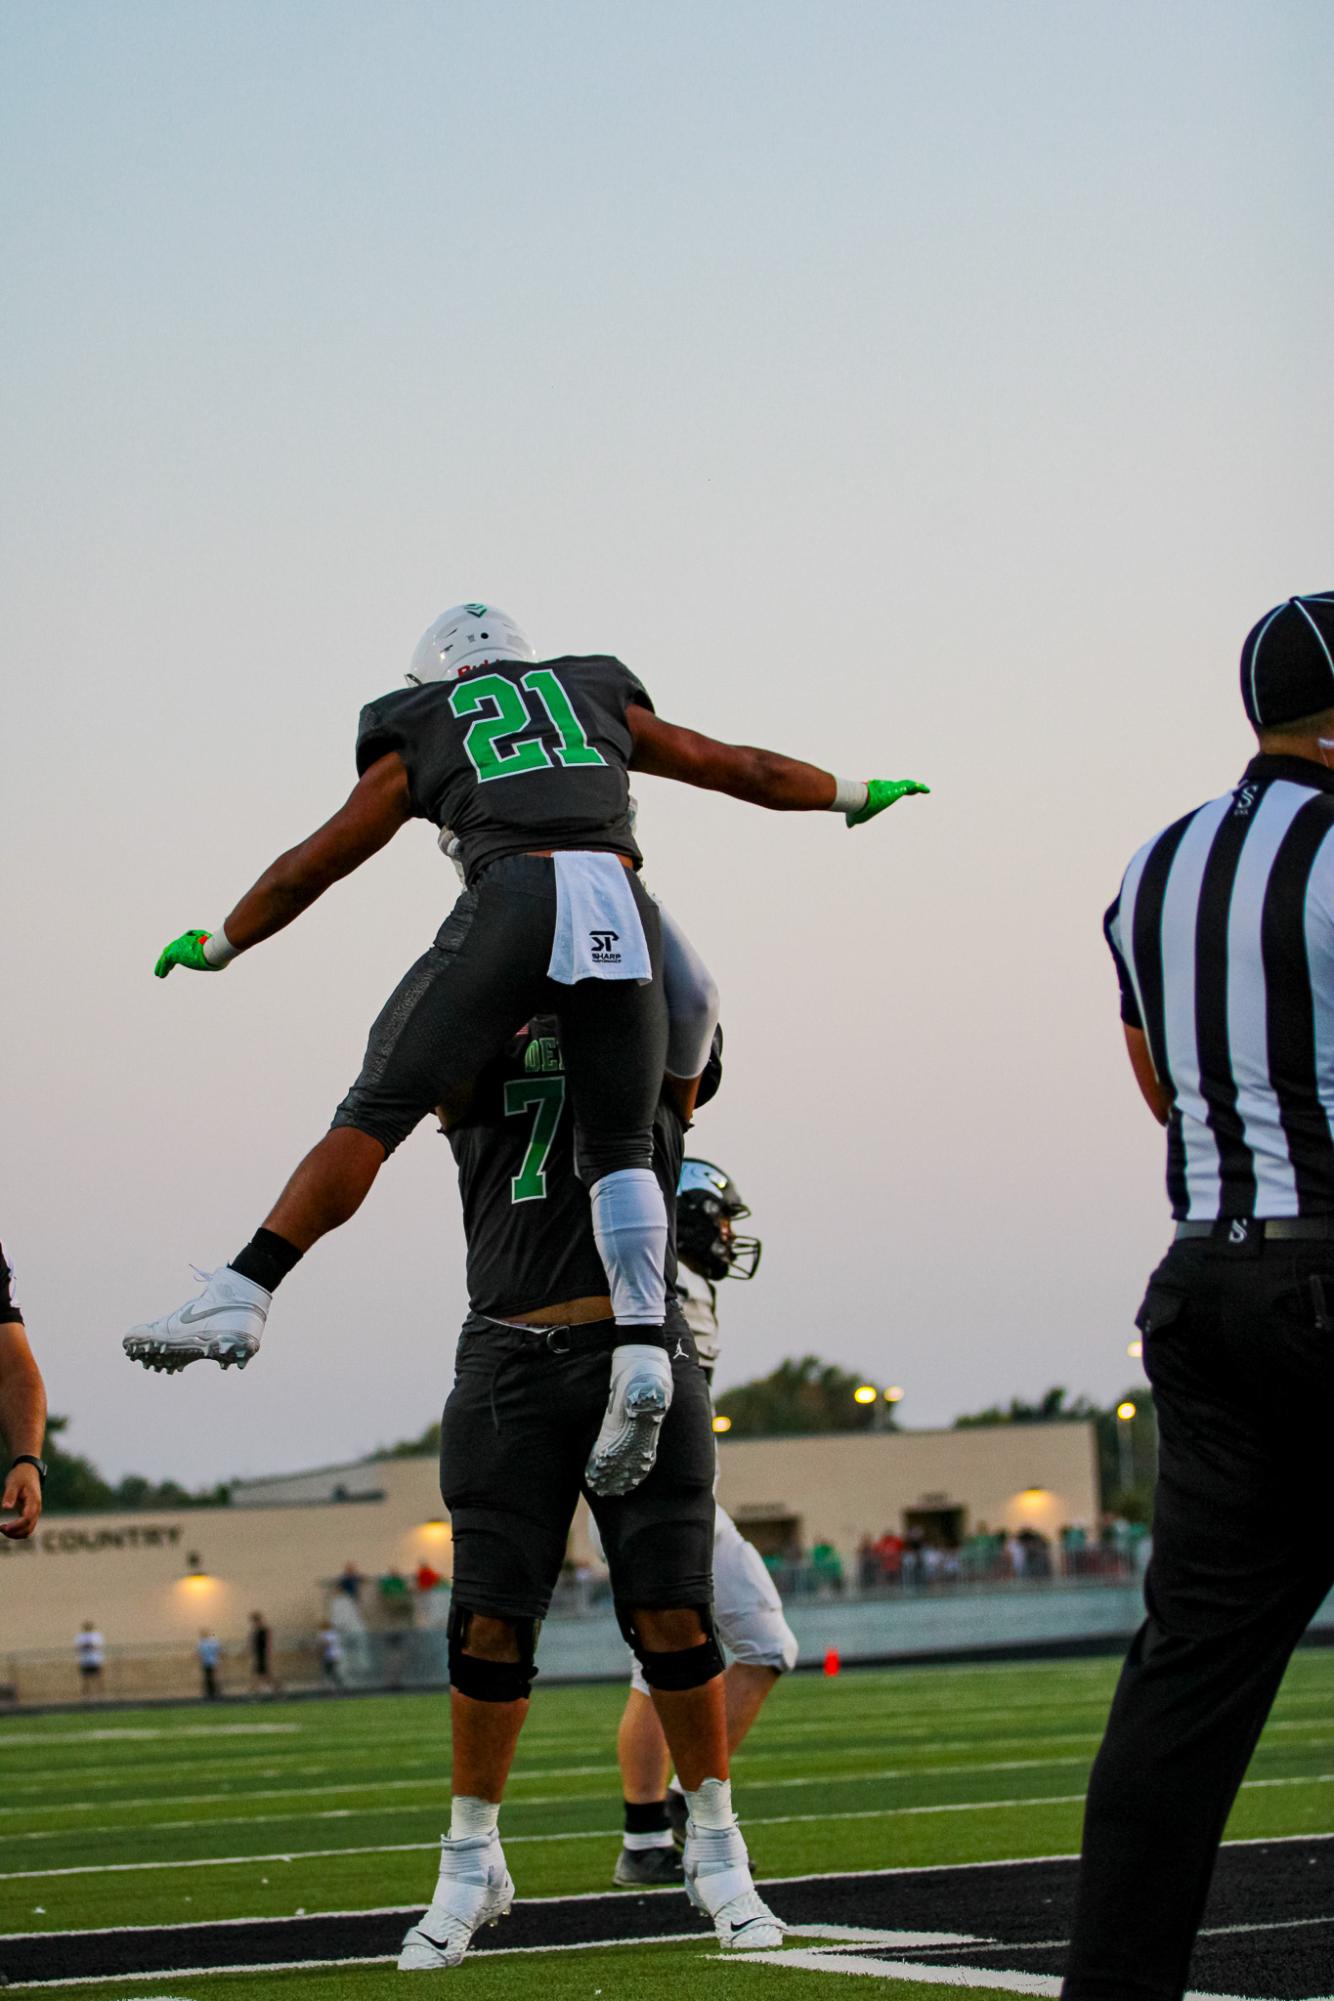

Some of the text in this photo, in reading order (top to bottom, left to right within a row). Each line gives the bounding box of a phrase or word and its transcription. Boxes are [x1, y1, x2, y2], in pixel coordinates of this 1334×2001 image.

[448, 669, 608, 784] 21
[504, 1075, 566, 1205] 7
[40, 1525, 184, 1555] COUNTRY
